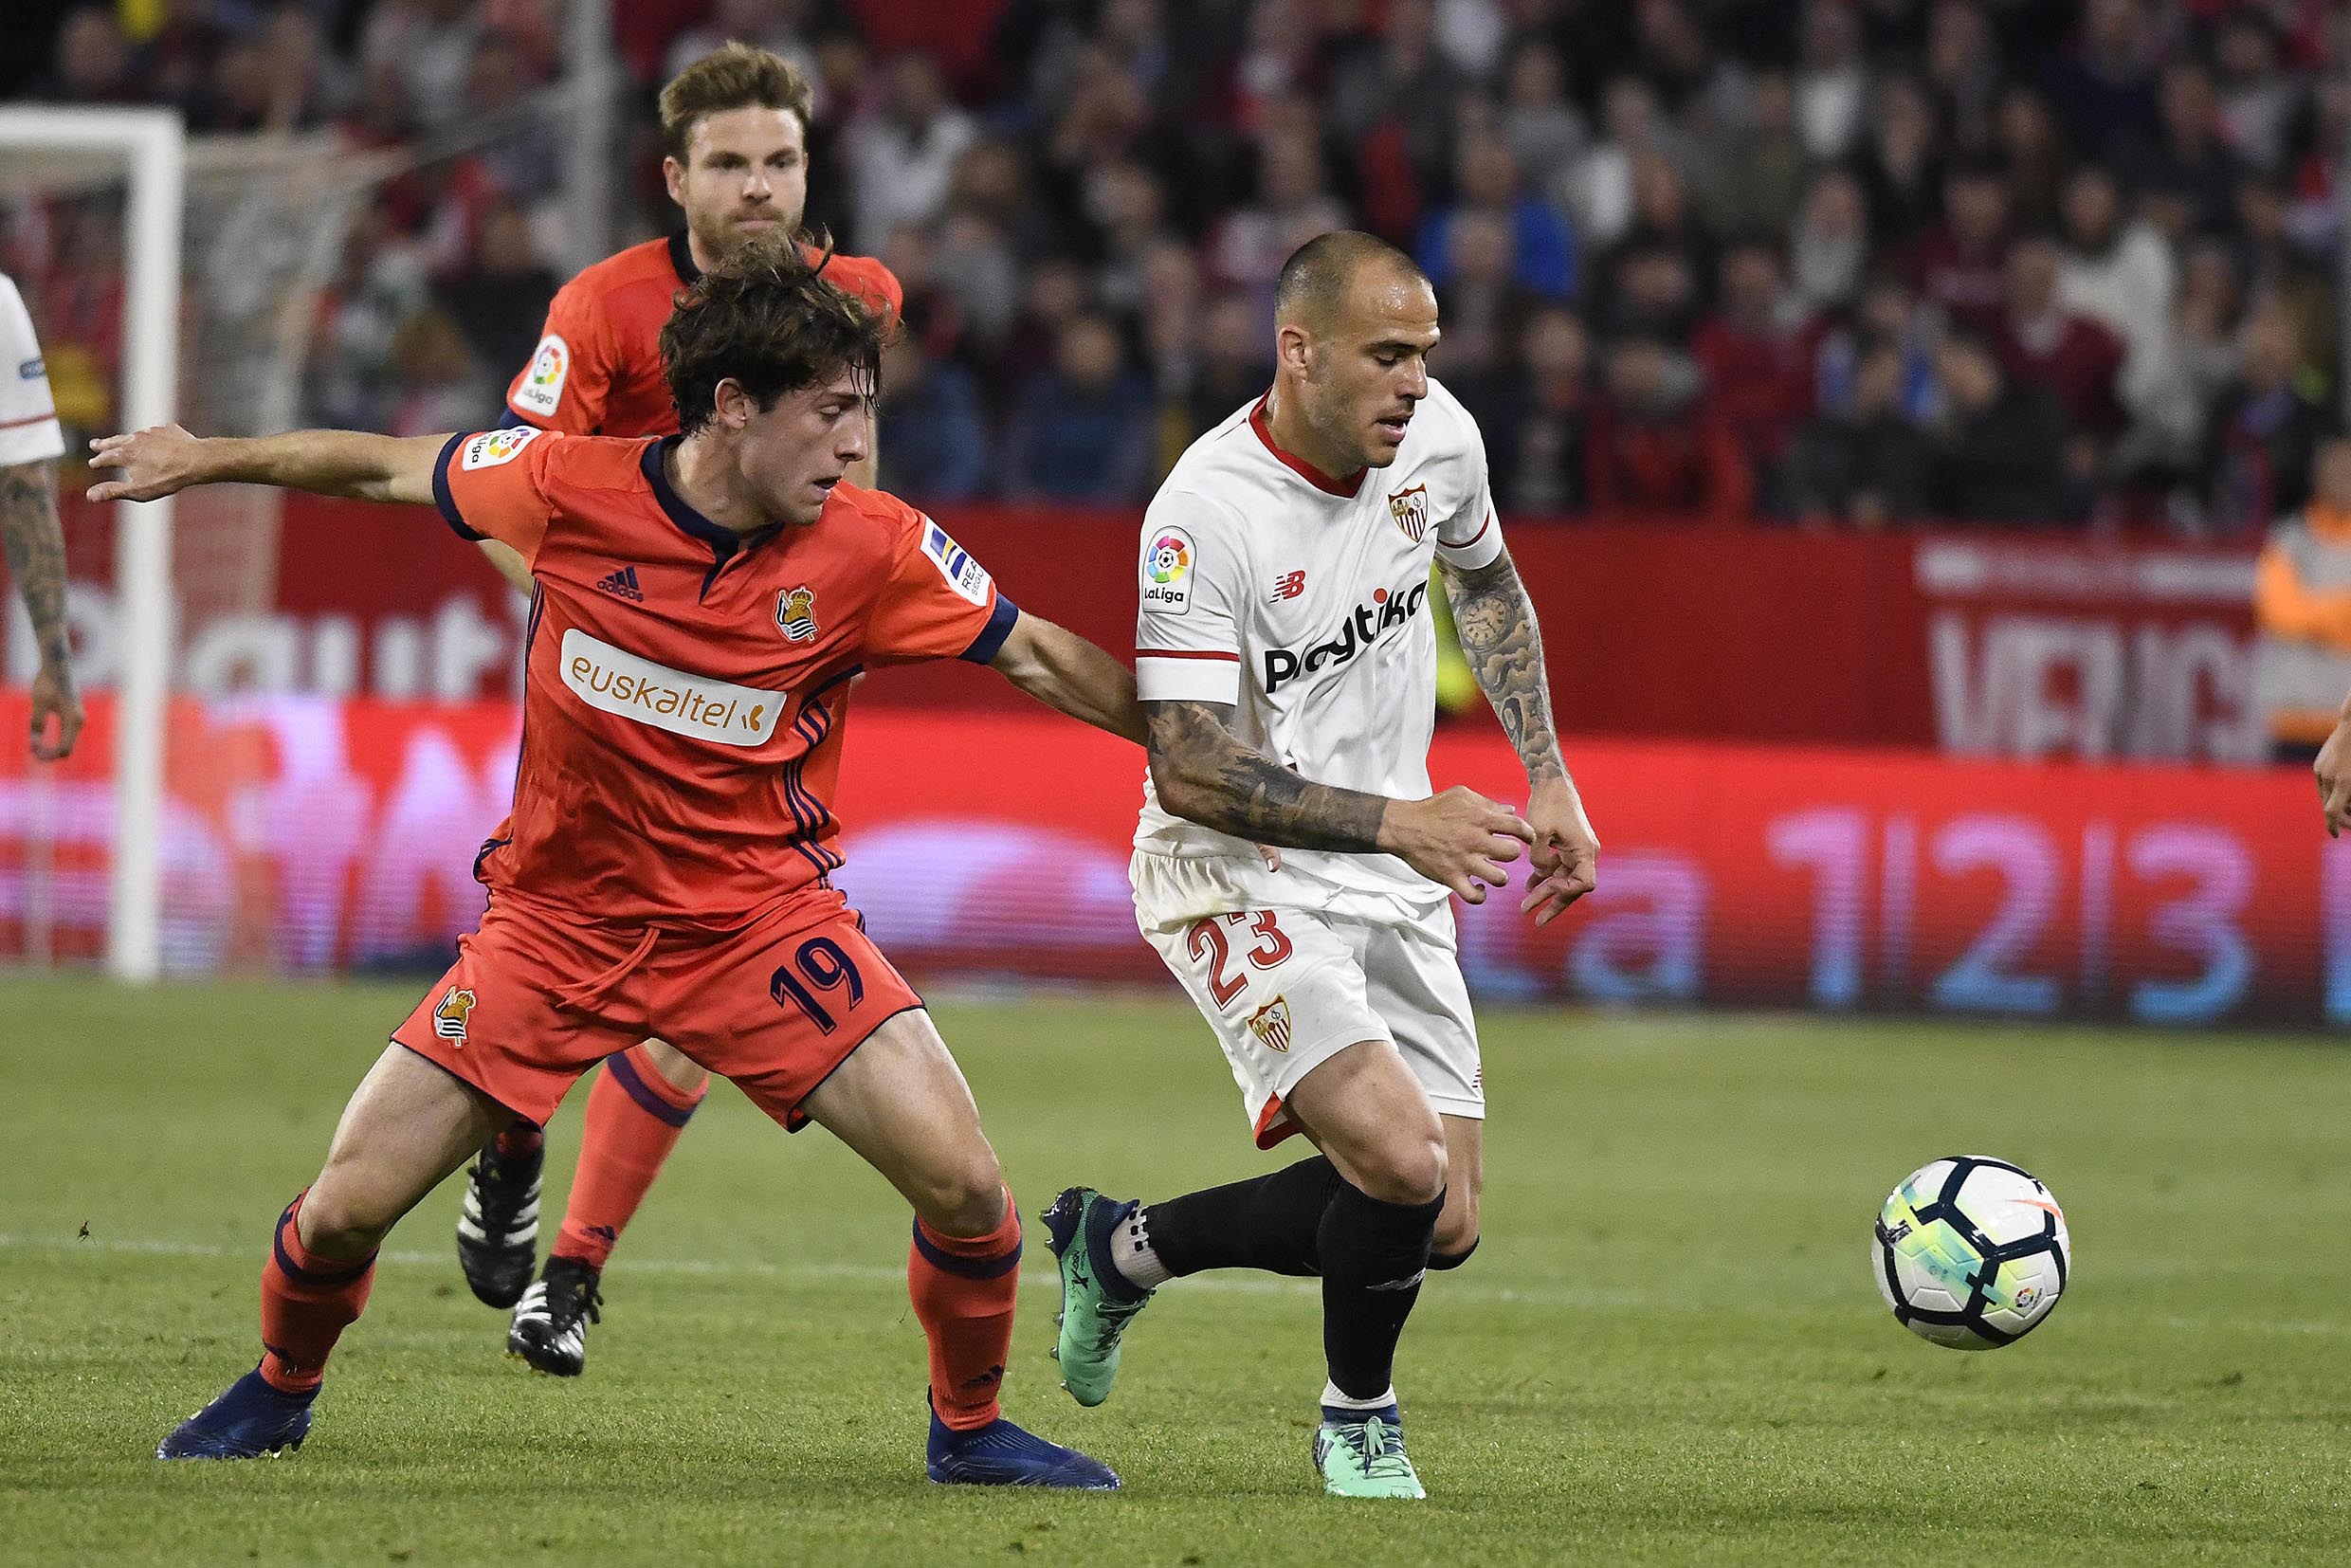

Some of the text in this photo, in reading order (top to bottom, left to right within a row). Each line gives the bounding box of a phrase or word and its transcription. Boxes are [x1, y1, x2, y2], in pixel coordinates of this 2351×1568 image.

[961, 560, 977, 591] REA
[971, 569, 984, 596] SEGU
[596, 580, 644, 603] adidas
[1144, 586, 1184, 604] LaLiga
[572, 655, 738, 730] euskaltel
[1187, 909, 1293, 1012] 23
[770, 937, 865, 1037] 19
